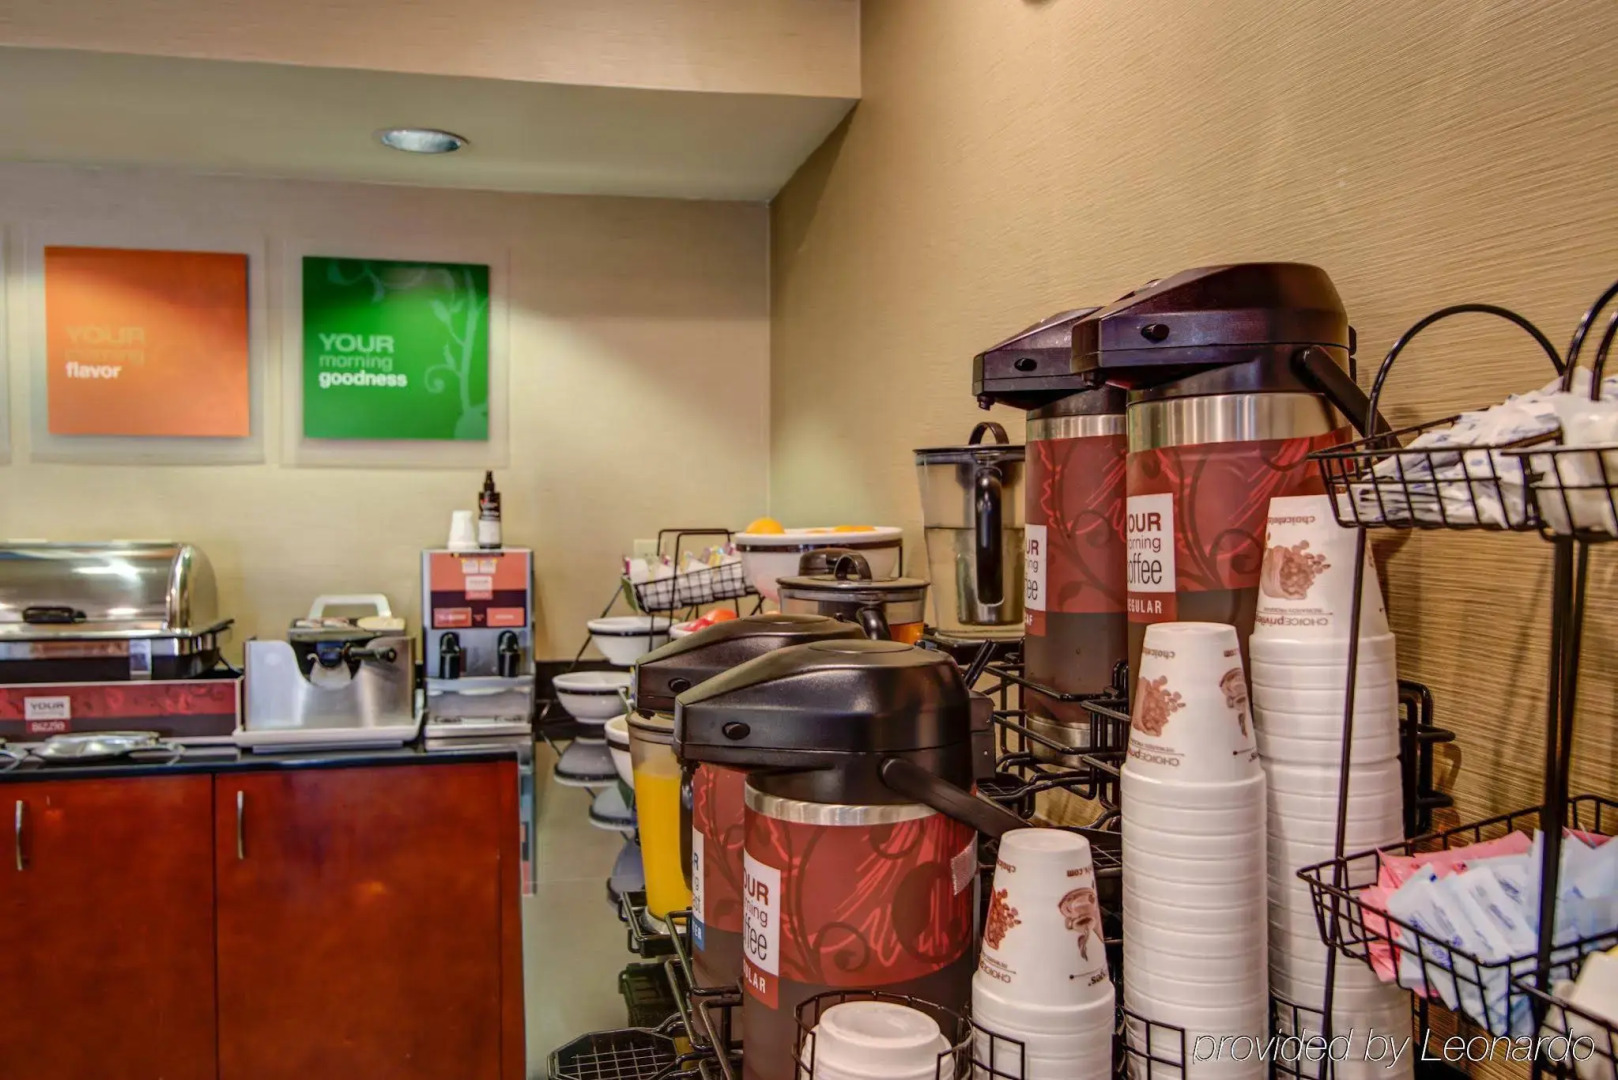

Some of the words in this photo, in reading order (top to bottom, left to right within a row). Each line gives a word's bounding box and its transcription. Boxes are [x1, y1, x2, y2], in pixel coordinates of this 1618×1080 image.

[64, 326, 145, 346] YOUR
[318, 333, 395, 353] YOUR
[65, 361, 122, 379] flavor
[319, 353, 393, 372] morning
[319, 369, 408, 389] goodness
[1128, 512, 1162, 532] OUR
[1128, 535, 1161, 553] orning
[1128, 553, 1163, 585] offee
[1128, 600, 1162, 615] EGULAR
